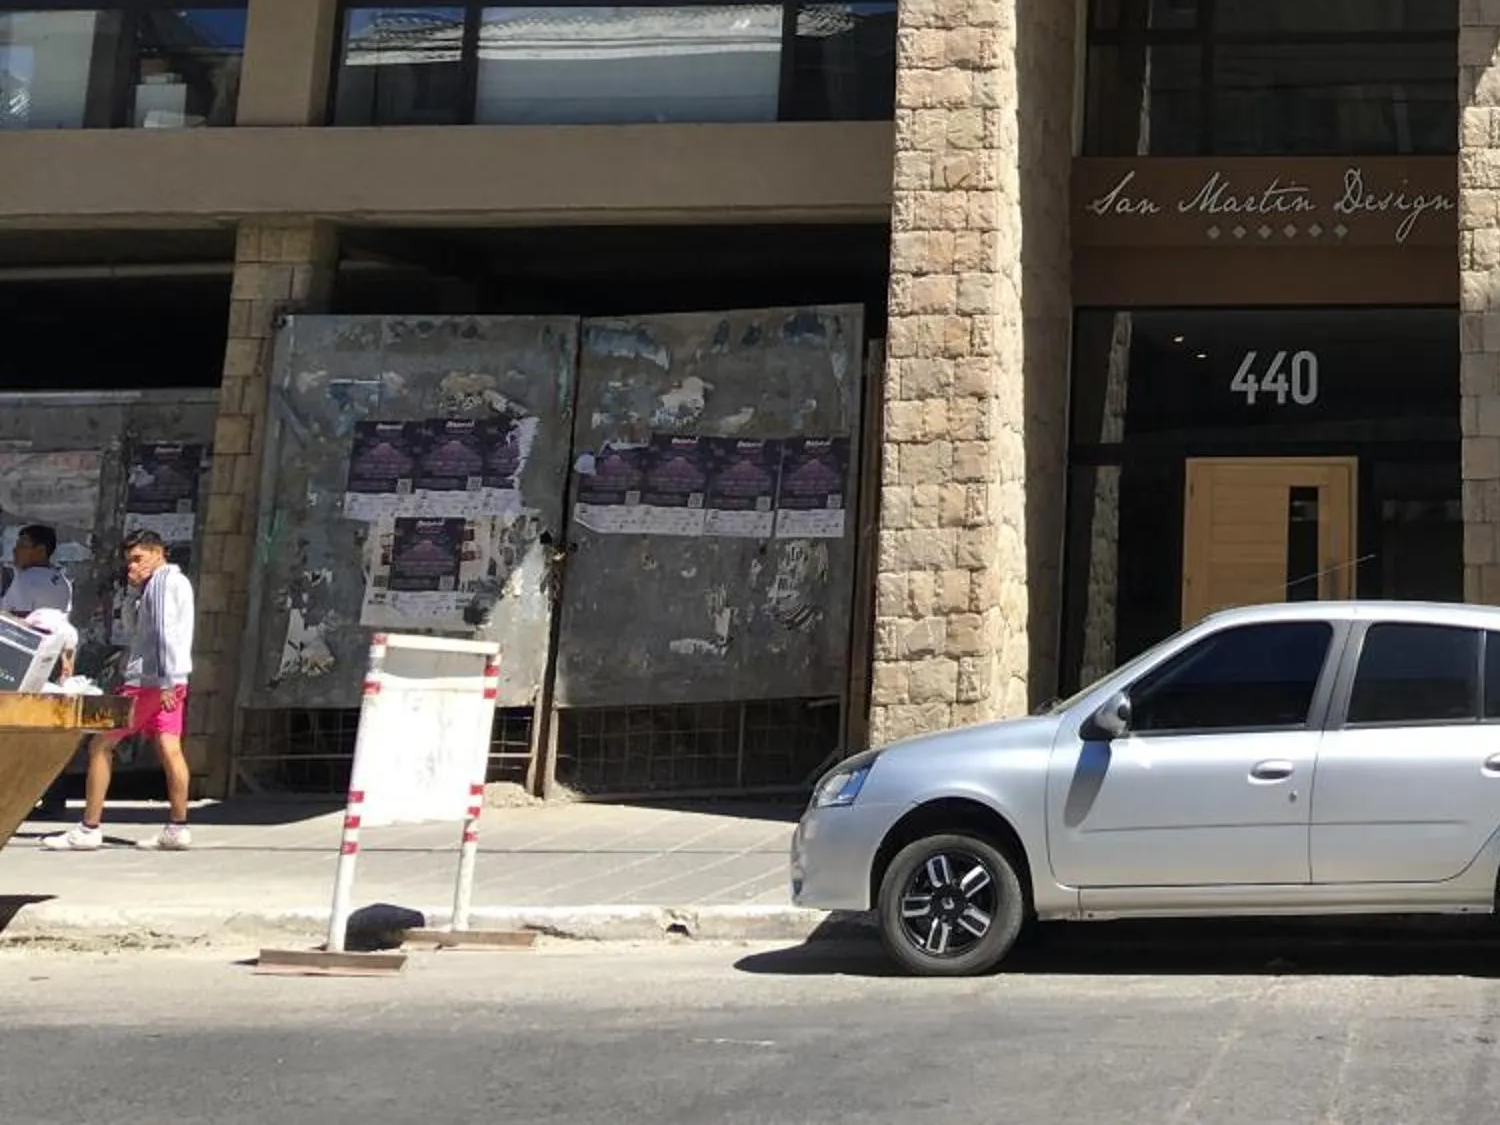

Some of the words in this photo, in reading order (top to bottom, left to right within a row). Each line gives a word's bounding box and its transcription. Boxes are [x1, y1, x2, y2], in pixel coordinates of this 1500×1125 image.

[1091, 170, 1160, 215] San
[1333, 169, 1455, 242] Design
[1230, 350, 1320, 405] 440
